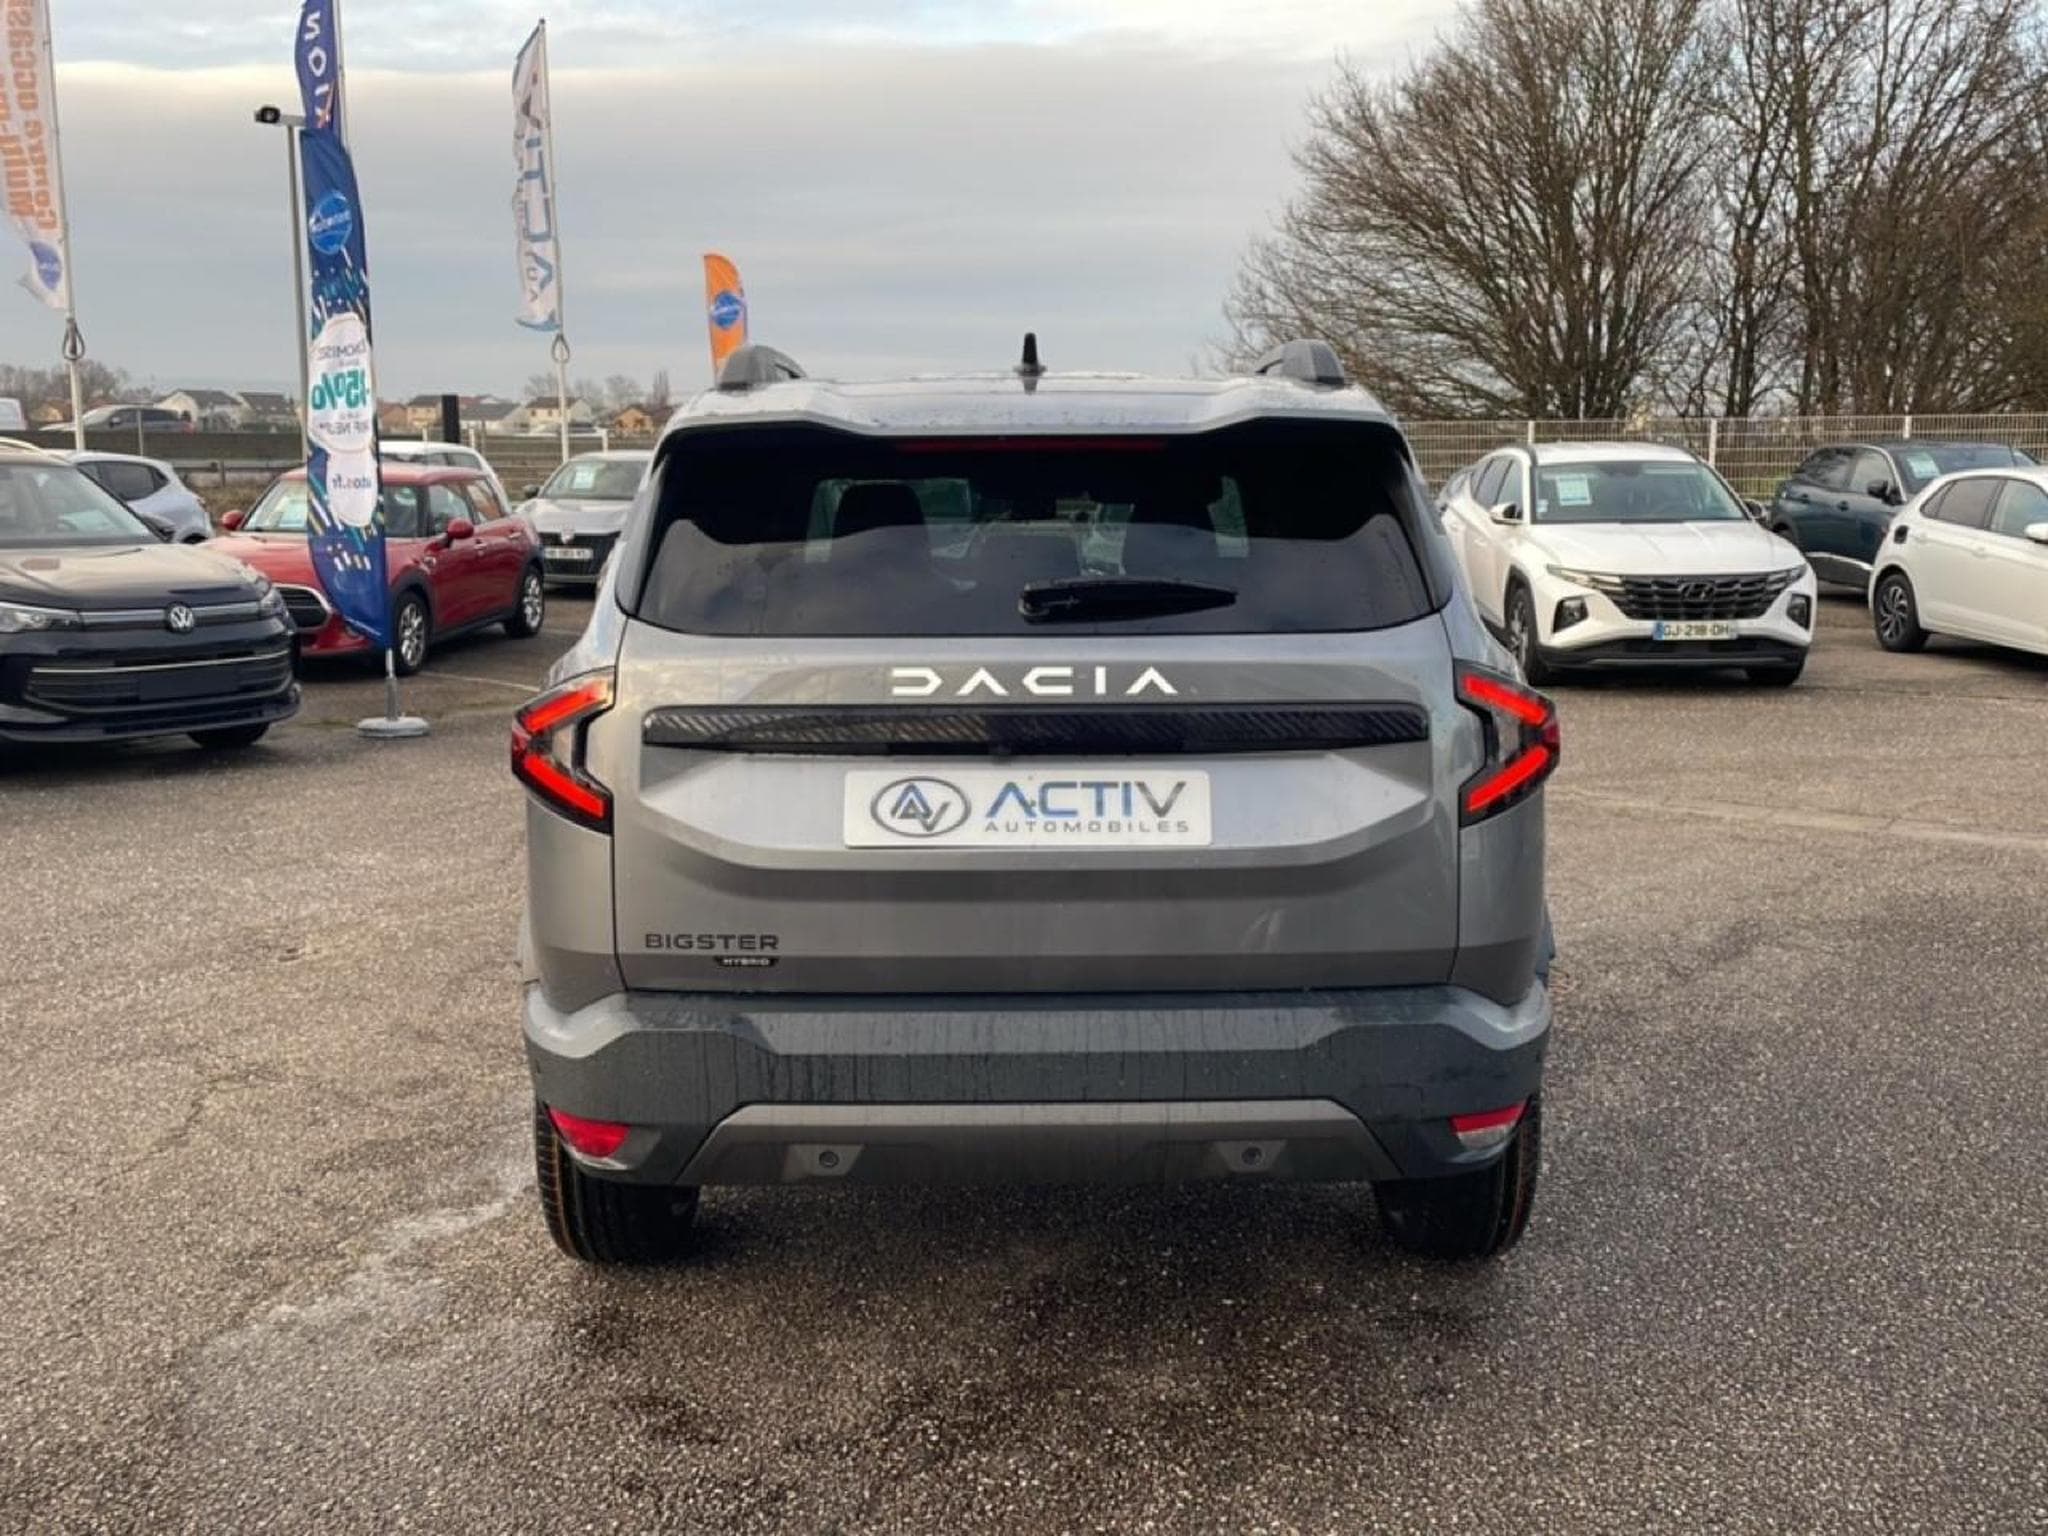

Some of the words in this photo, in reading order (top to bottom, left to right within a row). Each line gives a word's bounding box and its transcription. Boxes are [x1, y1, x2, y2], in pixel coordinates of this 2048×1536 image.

[891, 666, 1179, 697] DACIA
[985, 780, 1188, 819] ACTIV
[984, 820, 1190, 834] AUTOMOBILES
[645, 933, 780, 951] BIGSTER
